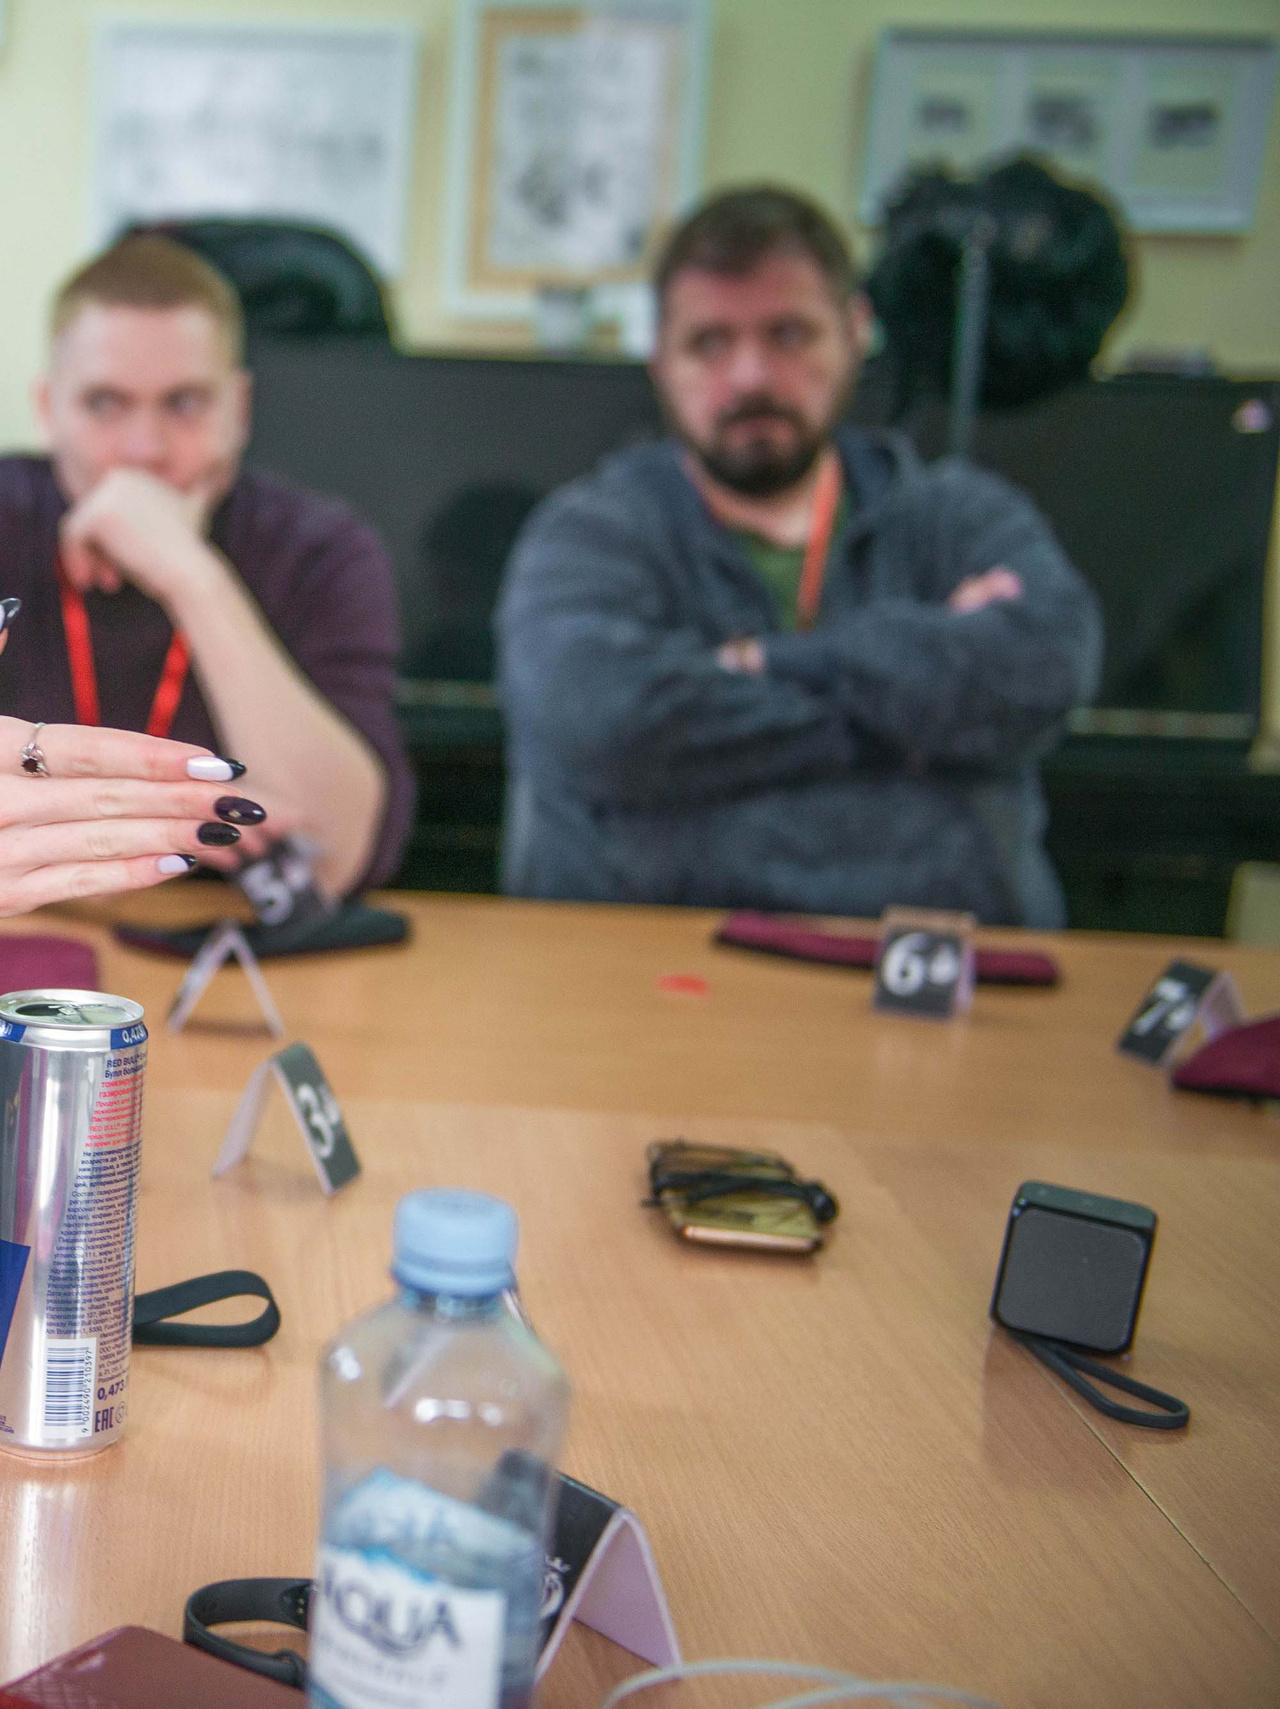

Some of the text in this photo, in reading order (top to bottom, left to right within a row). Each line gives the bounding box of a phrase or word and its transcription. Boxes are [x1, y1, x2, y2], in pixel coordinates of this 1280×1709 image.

[883, 932, 931, 996] 6
[1134, 979, 1187, 1036] 7
[107, 1058, 122, 1068] RED
[297, 1083, 334, 1159] 3
